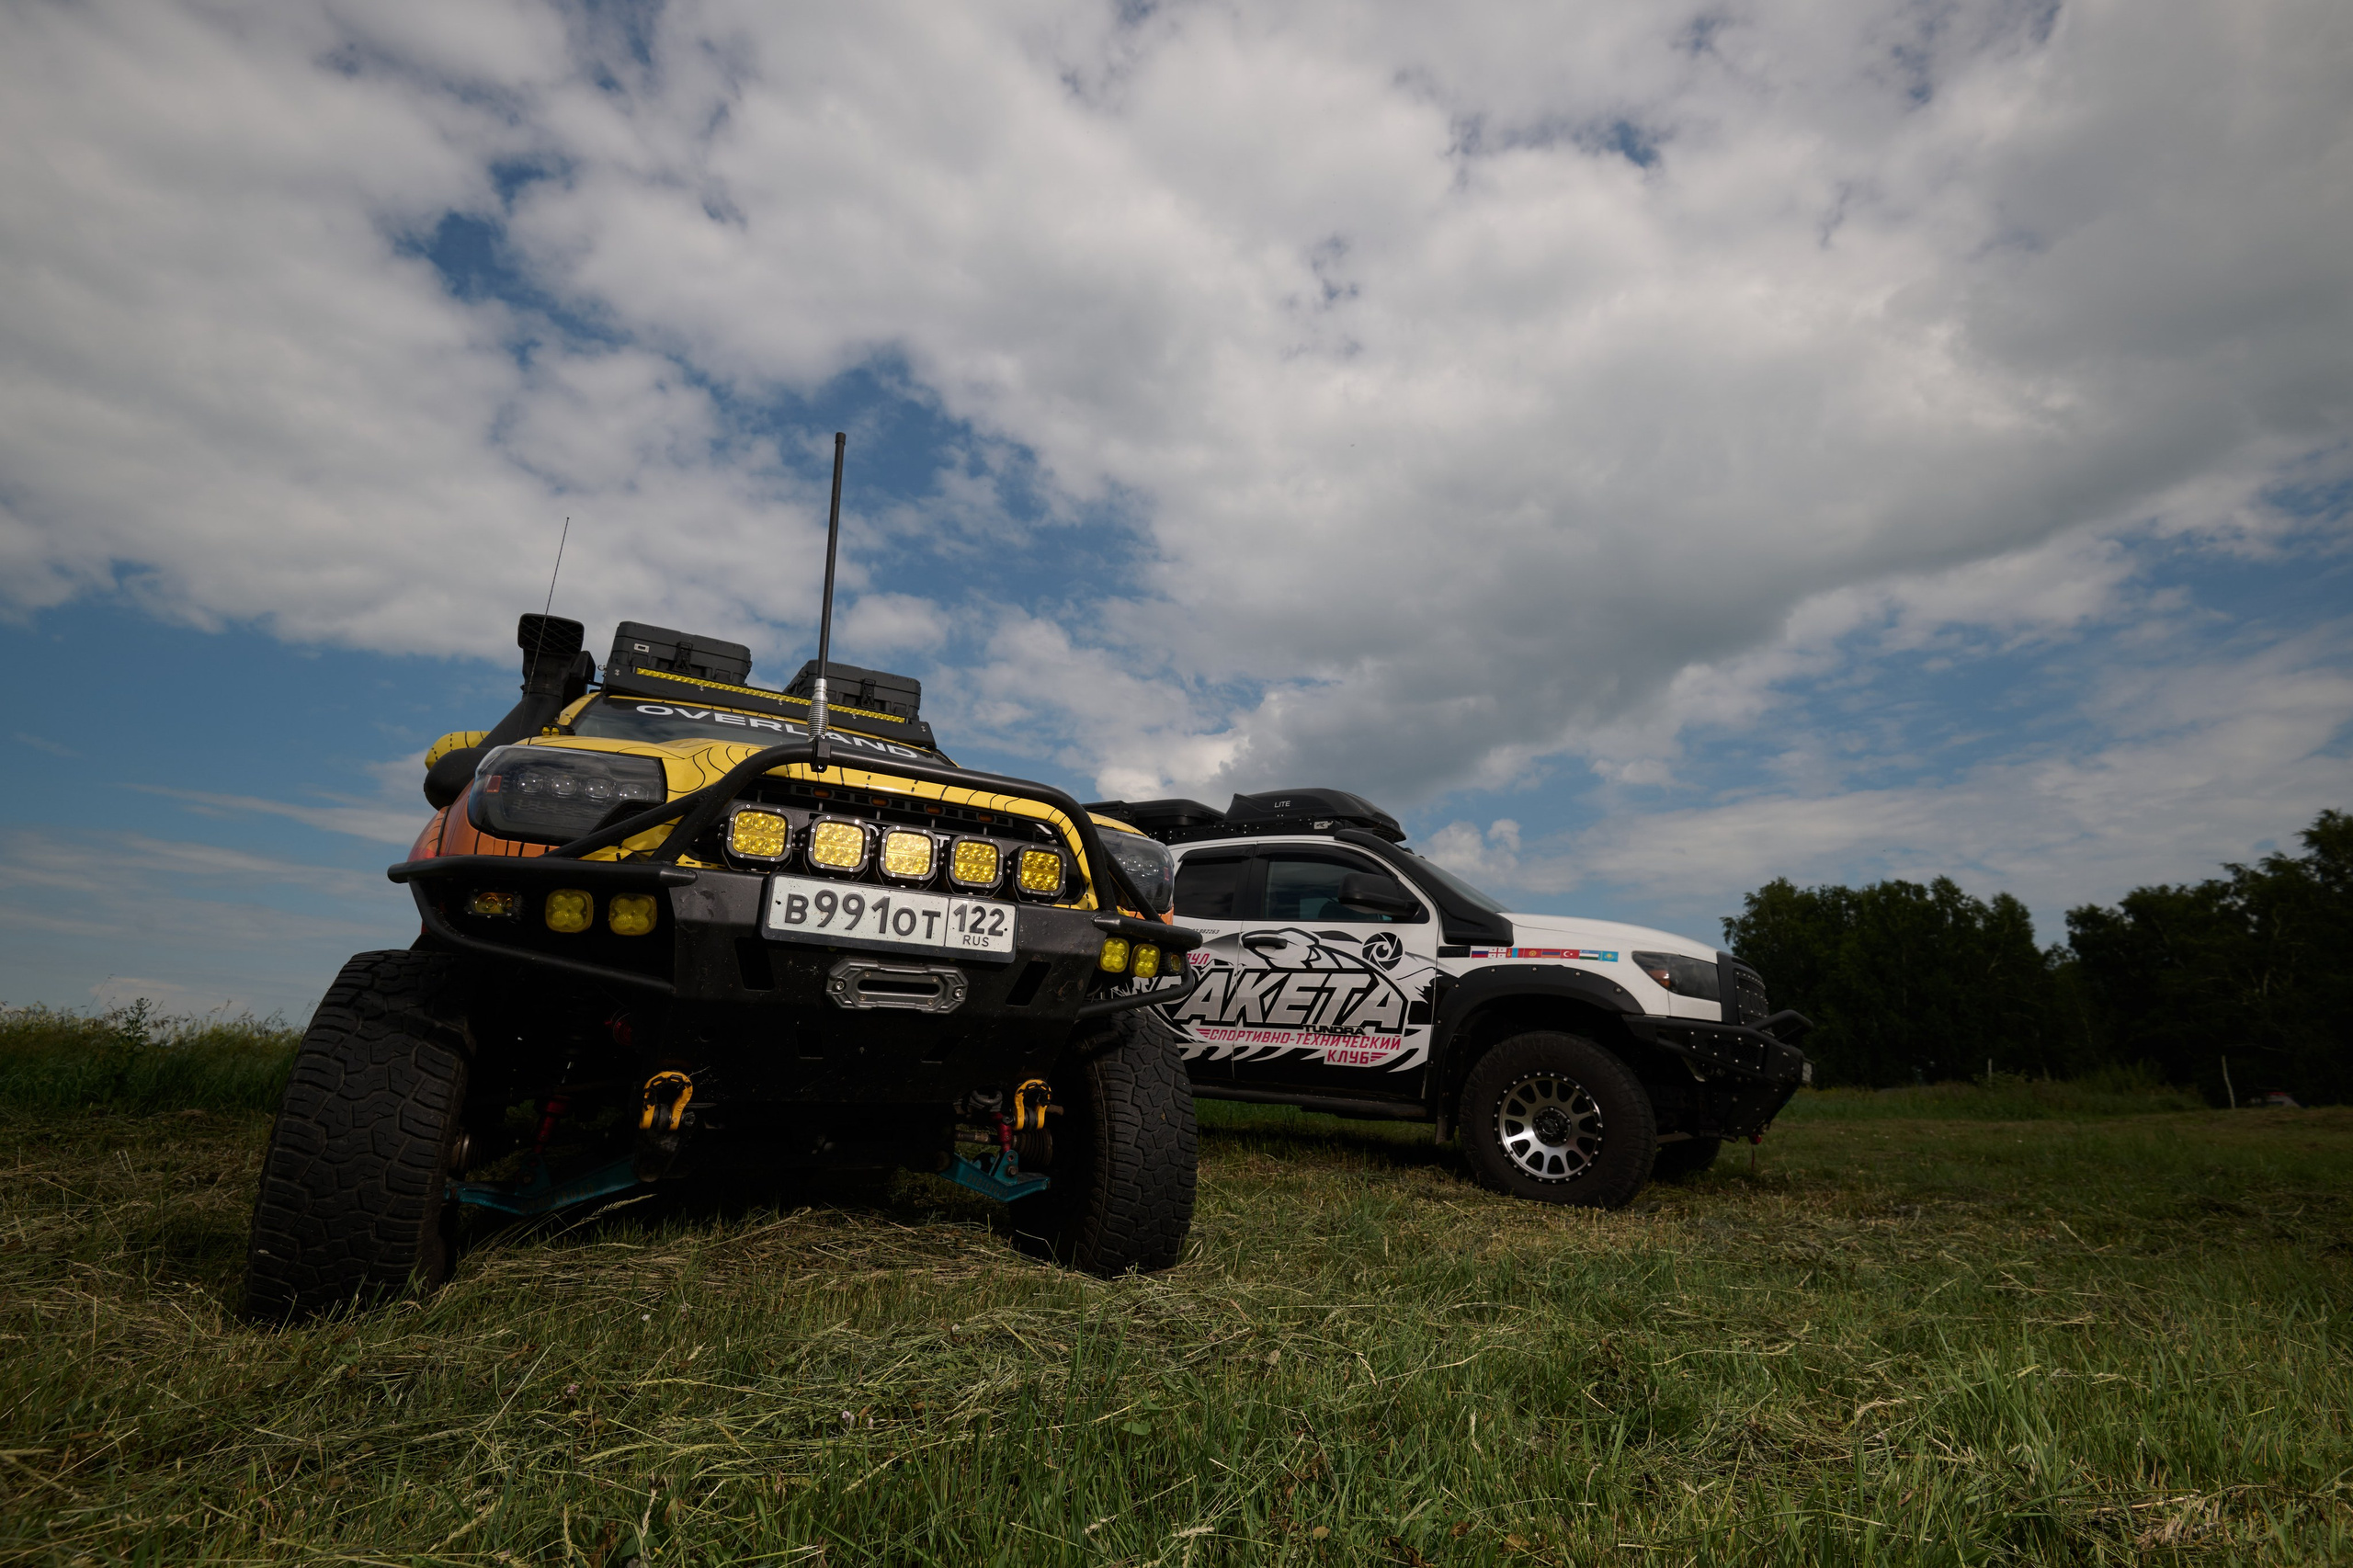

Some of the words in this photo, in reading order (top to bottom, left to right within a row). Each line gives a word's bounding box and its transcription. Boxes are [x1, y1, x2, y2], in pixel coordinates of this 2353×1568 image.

[636, 705, 917, 759] OVERLAND
[953, 903, 1006, 937] 122
[962, 935, 990, 948] RUS
[1302, 1024, 1366, 1036] TUNDRA
[1210, 1028, 1402, 1051] СПОРТИВНО-ТЕХНИЧЕСКИЙ
[1327, 1050, 1370, 1064] КЛУБ
